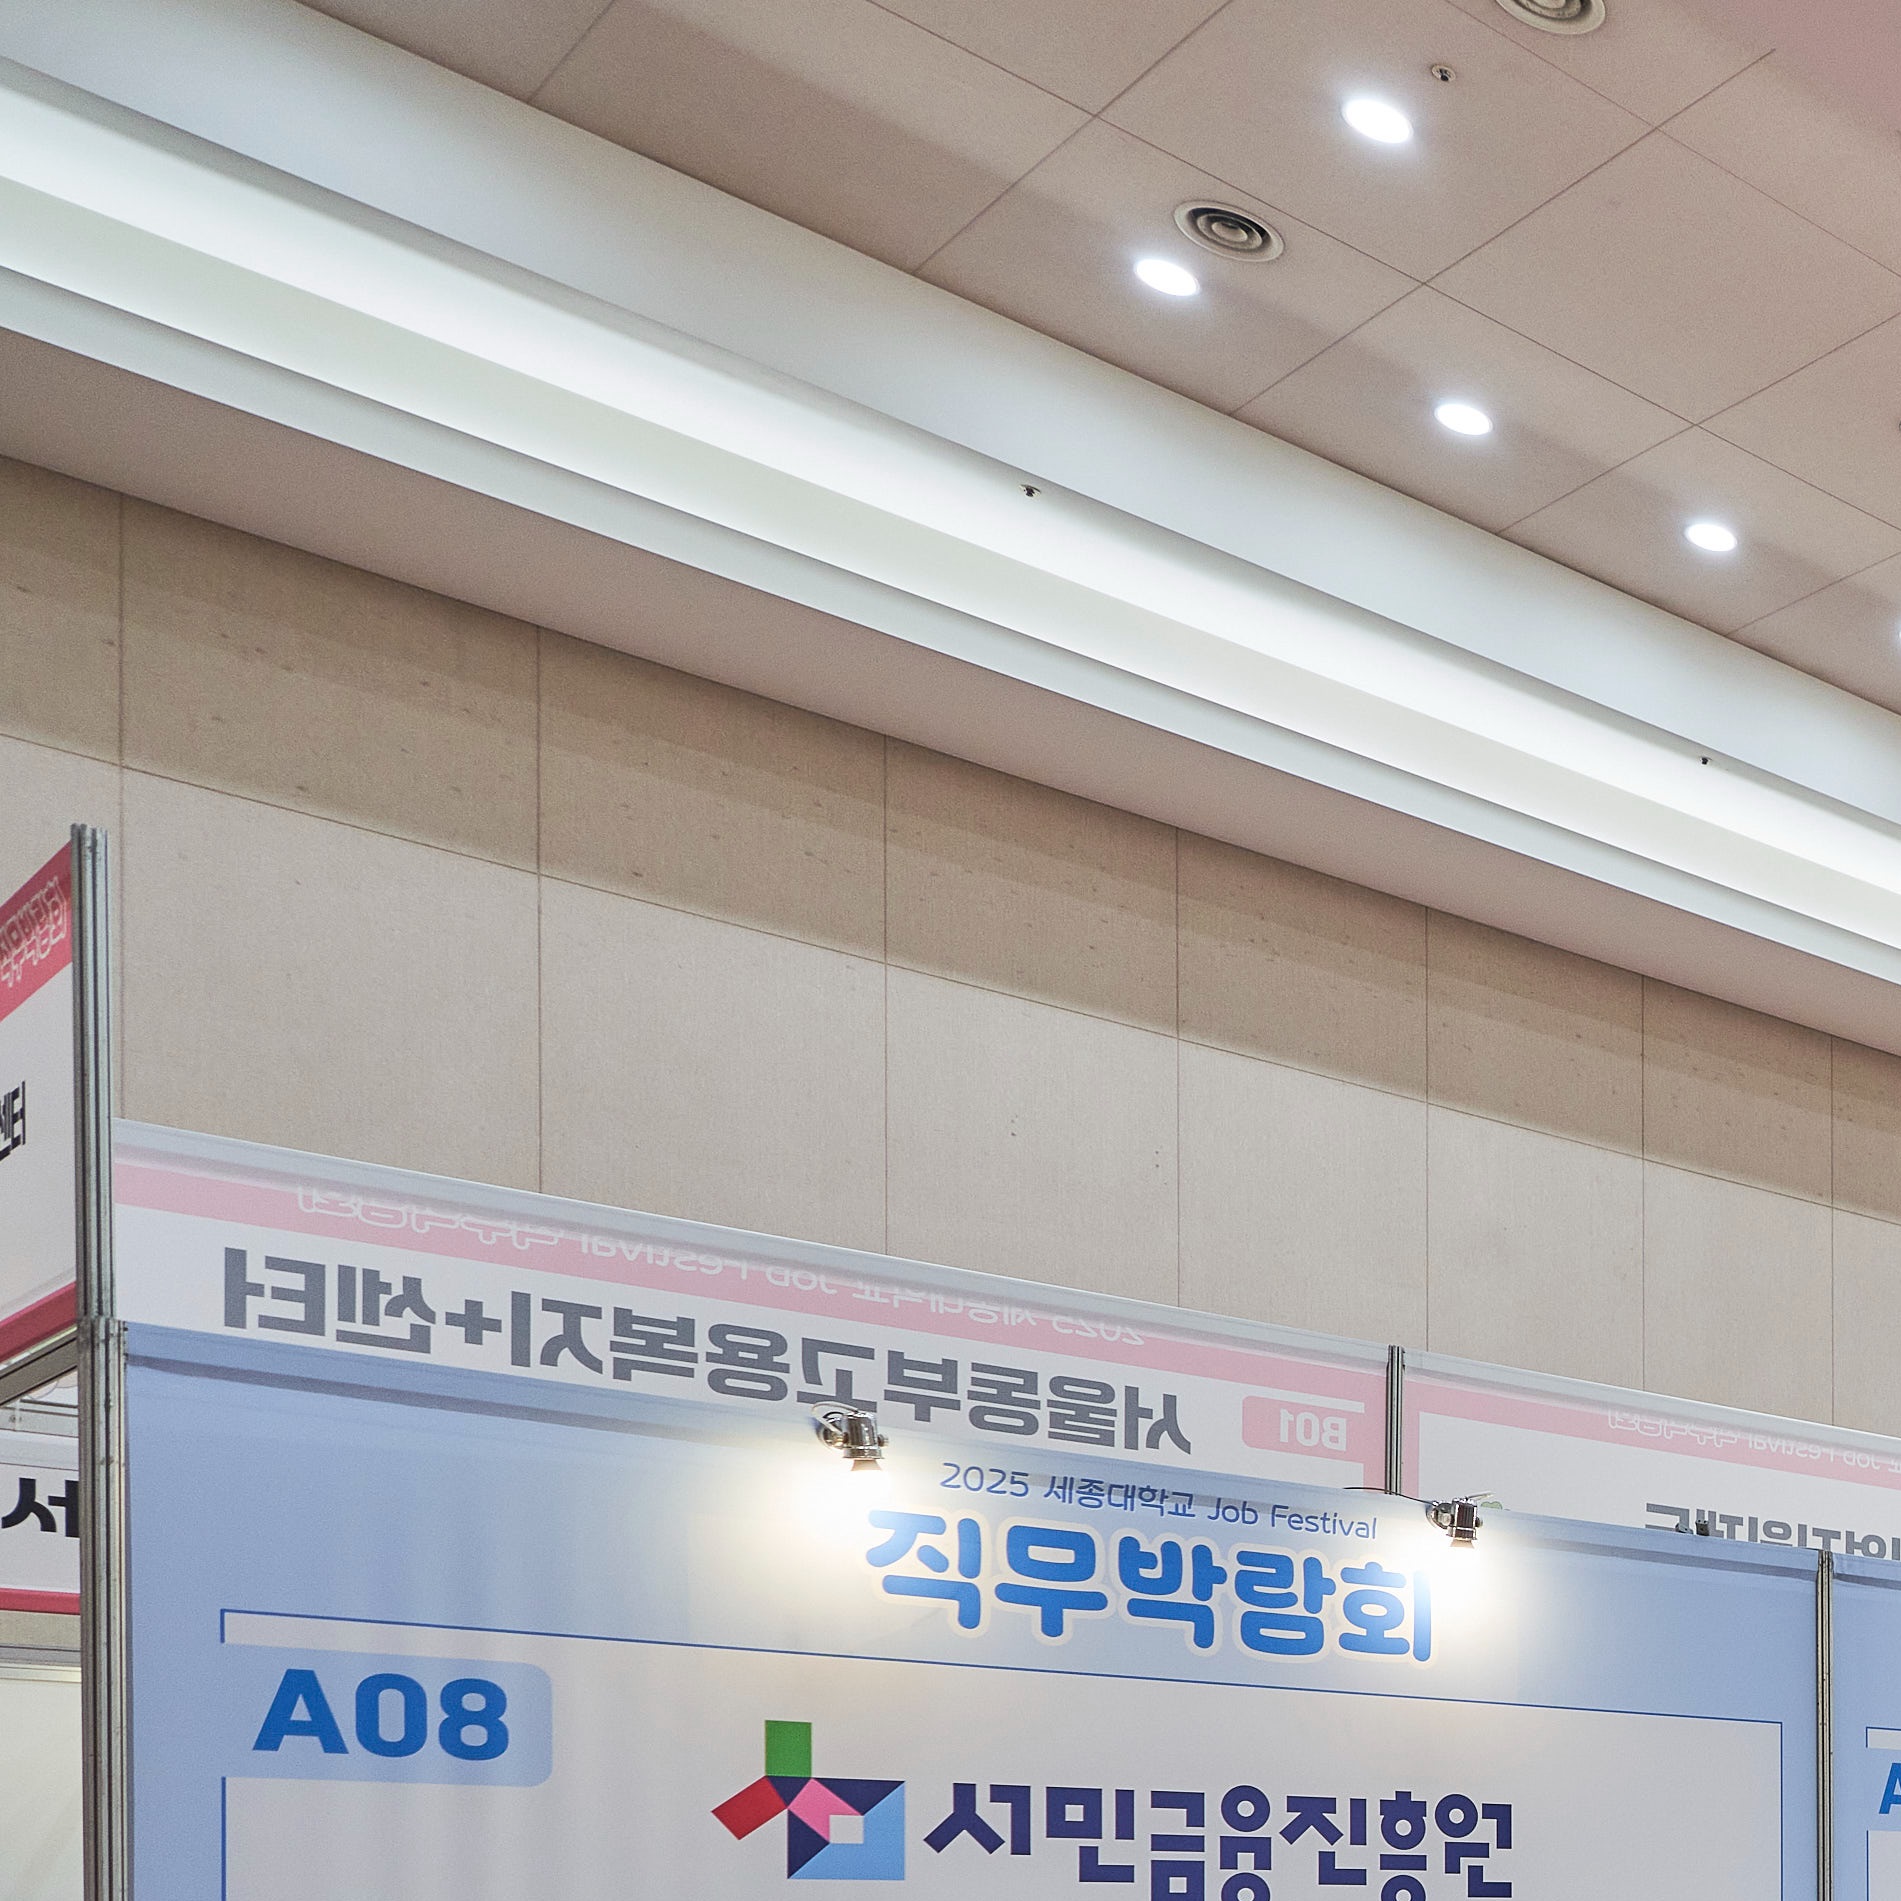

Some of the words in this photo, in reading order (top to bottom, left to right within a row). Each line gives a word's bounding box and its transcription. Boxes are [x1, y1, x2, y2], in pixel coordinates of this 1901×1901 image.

[940, 1462, 1030, 1498] 2025
[1044, 1474, 1196, 1519] 세종대학교
[1207, 1498, 1259, 1526] Job
[1270, 1504, 1378, 1540] Festival
[865, 1508, 1433, 1662] 직무박람회
[252, 1668, 510, 1761] A08
